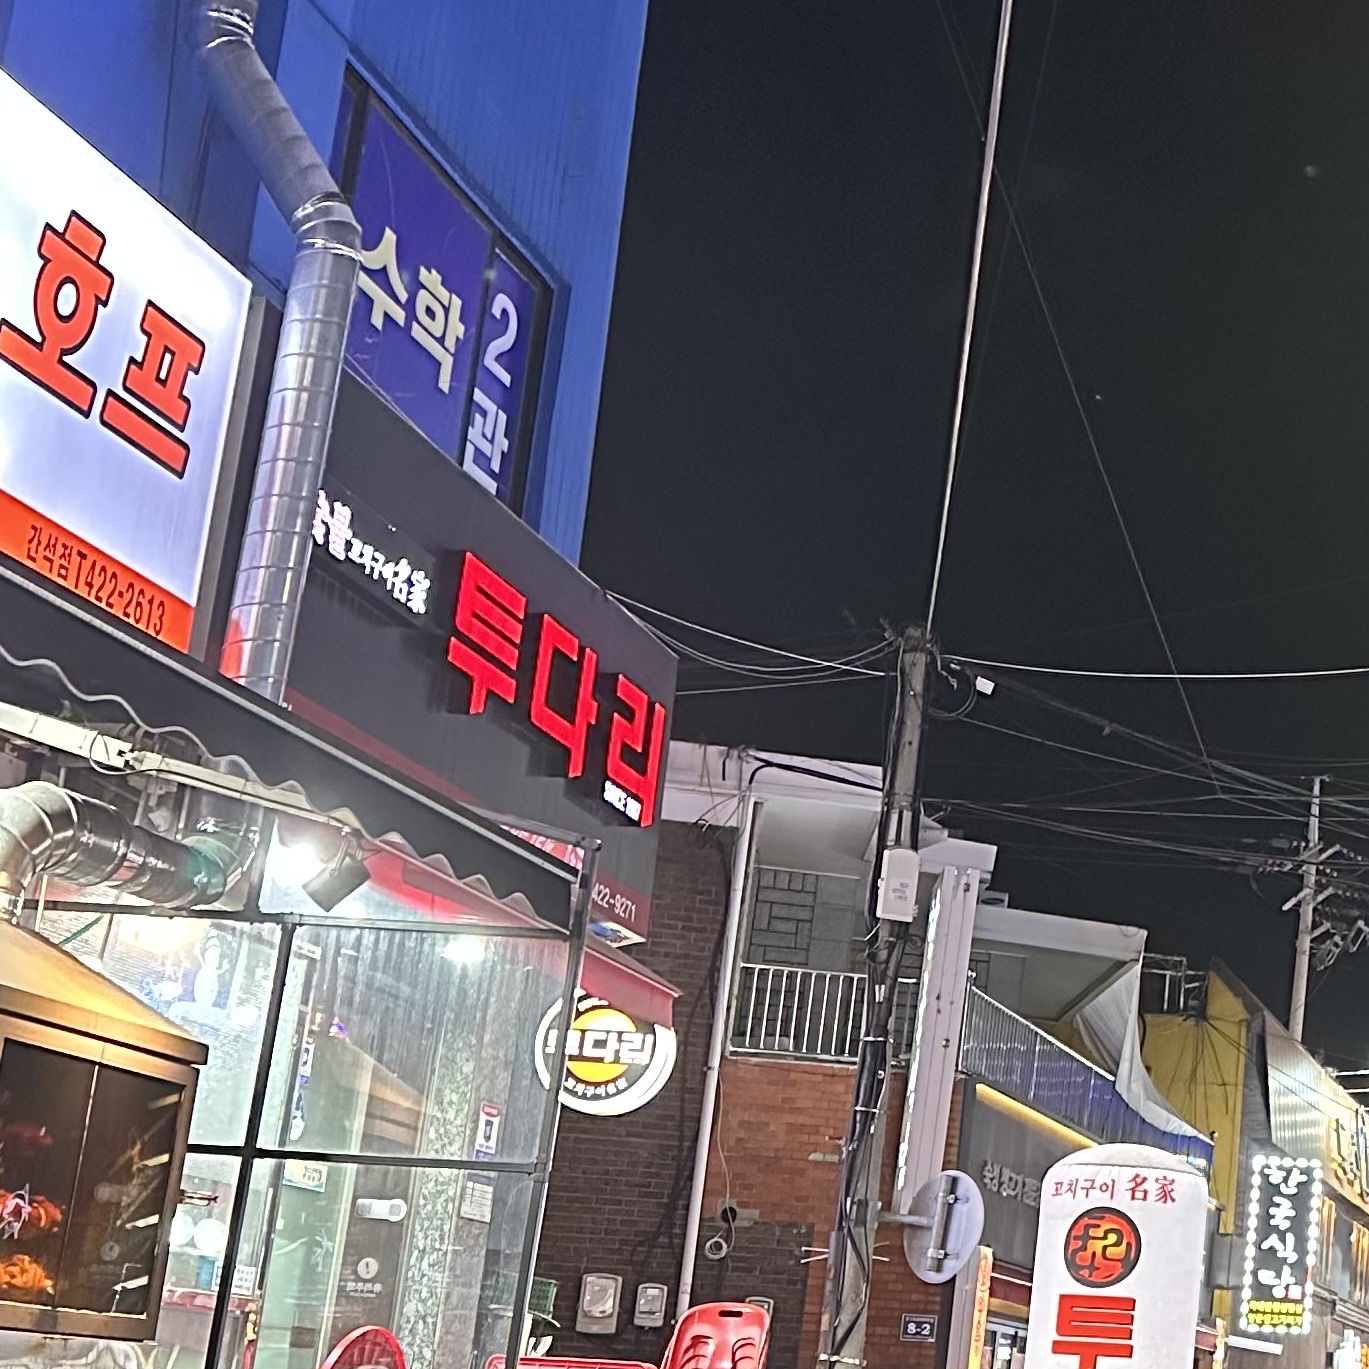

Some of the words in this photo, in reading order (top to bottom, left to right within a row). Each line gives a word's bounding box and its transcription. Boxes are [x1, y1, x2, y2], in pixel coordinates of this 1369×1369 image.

[0, 210, 206, 479] 호프
[358, 226, 465, 394] 수학
[464, 292, 518, 495] 2관
[27, 524, 73, 582] 간석점
[75, 549, 165, 637] T422-2613
[447, 551, 666, 828] 투다리
[1051, 1177, 1116, 1201] 꼬치구이
[1125, 1173, 1177, 1204] 名家
[1257, 1165, 1309, 1299] 한국식당
[907, 1322, 931, 1335] 8-2
